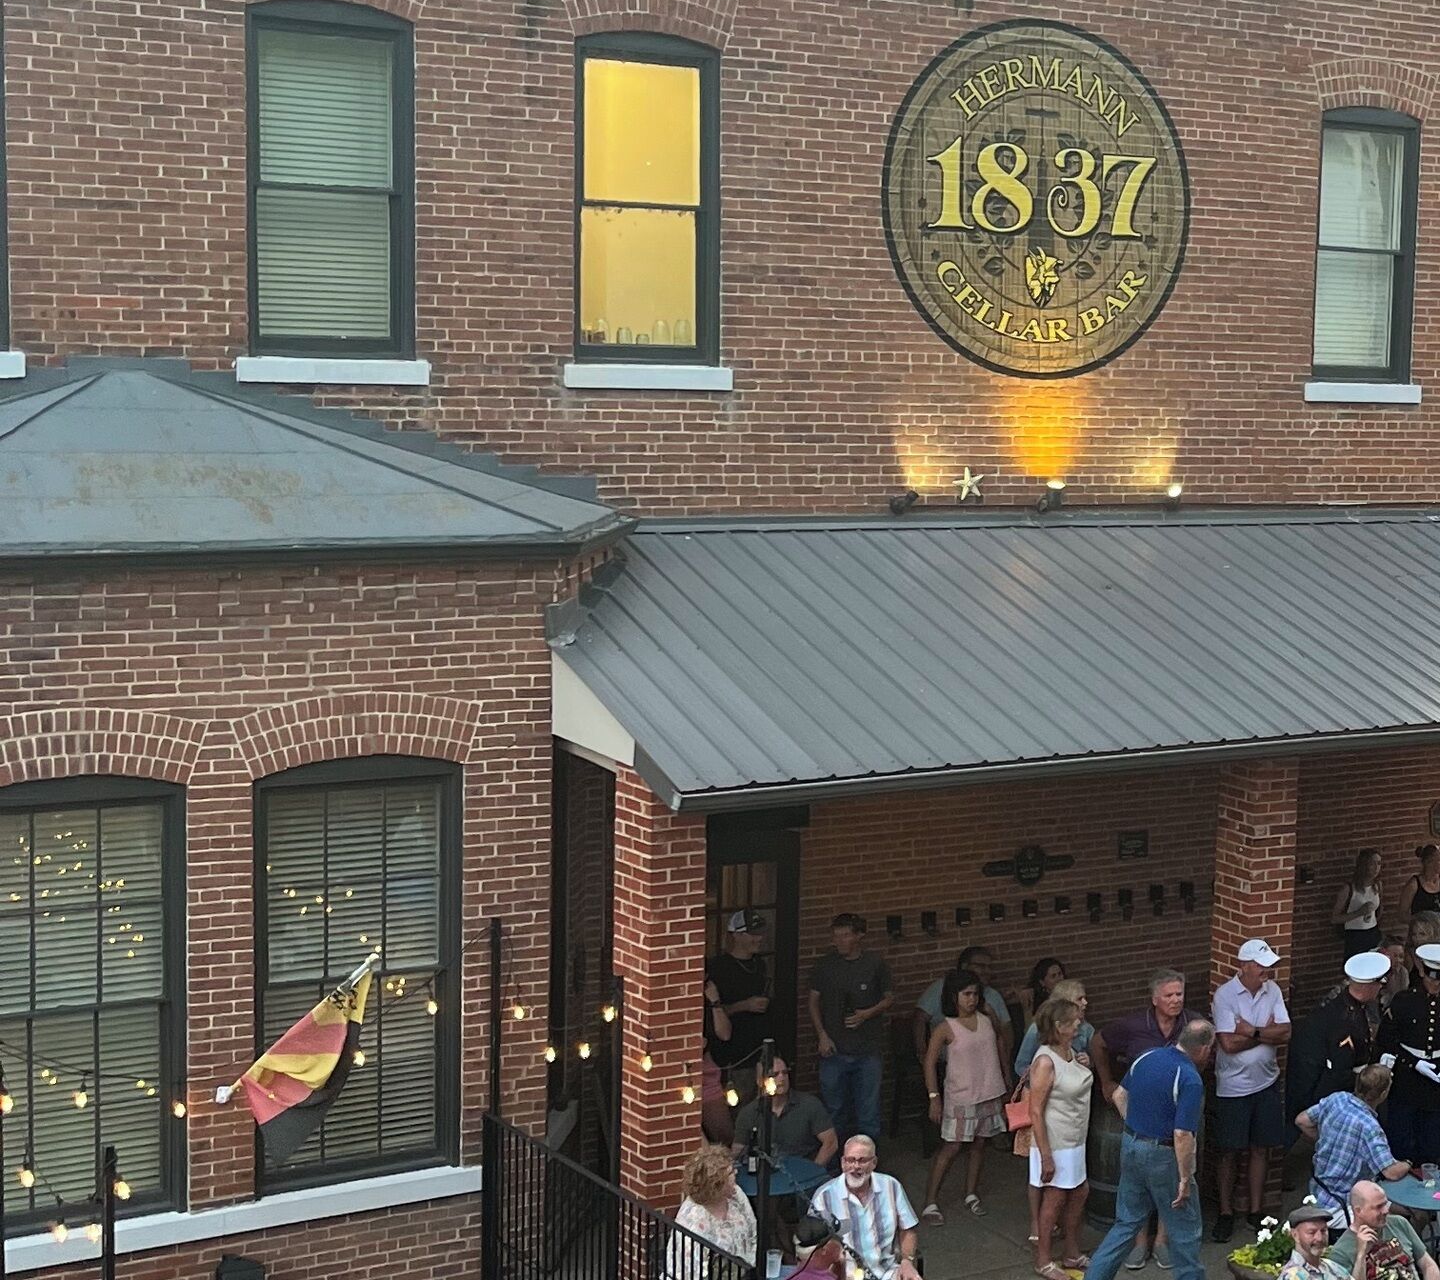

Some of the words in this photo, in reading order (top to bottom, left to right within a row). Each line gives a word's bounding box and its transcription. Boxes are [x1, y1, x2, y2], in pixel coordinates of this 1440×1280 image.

[951, 55, 1141, 137] HERMANN
[927, 136, 1158, 238] 1837
[937, 260, 1074, 343] CELLAR
[1080, 269, 1148, 337] BAR
